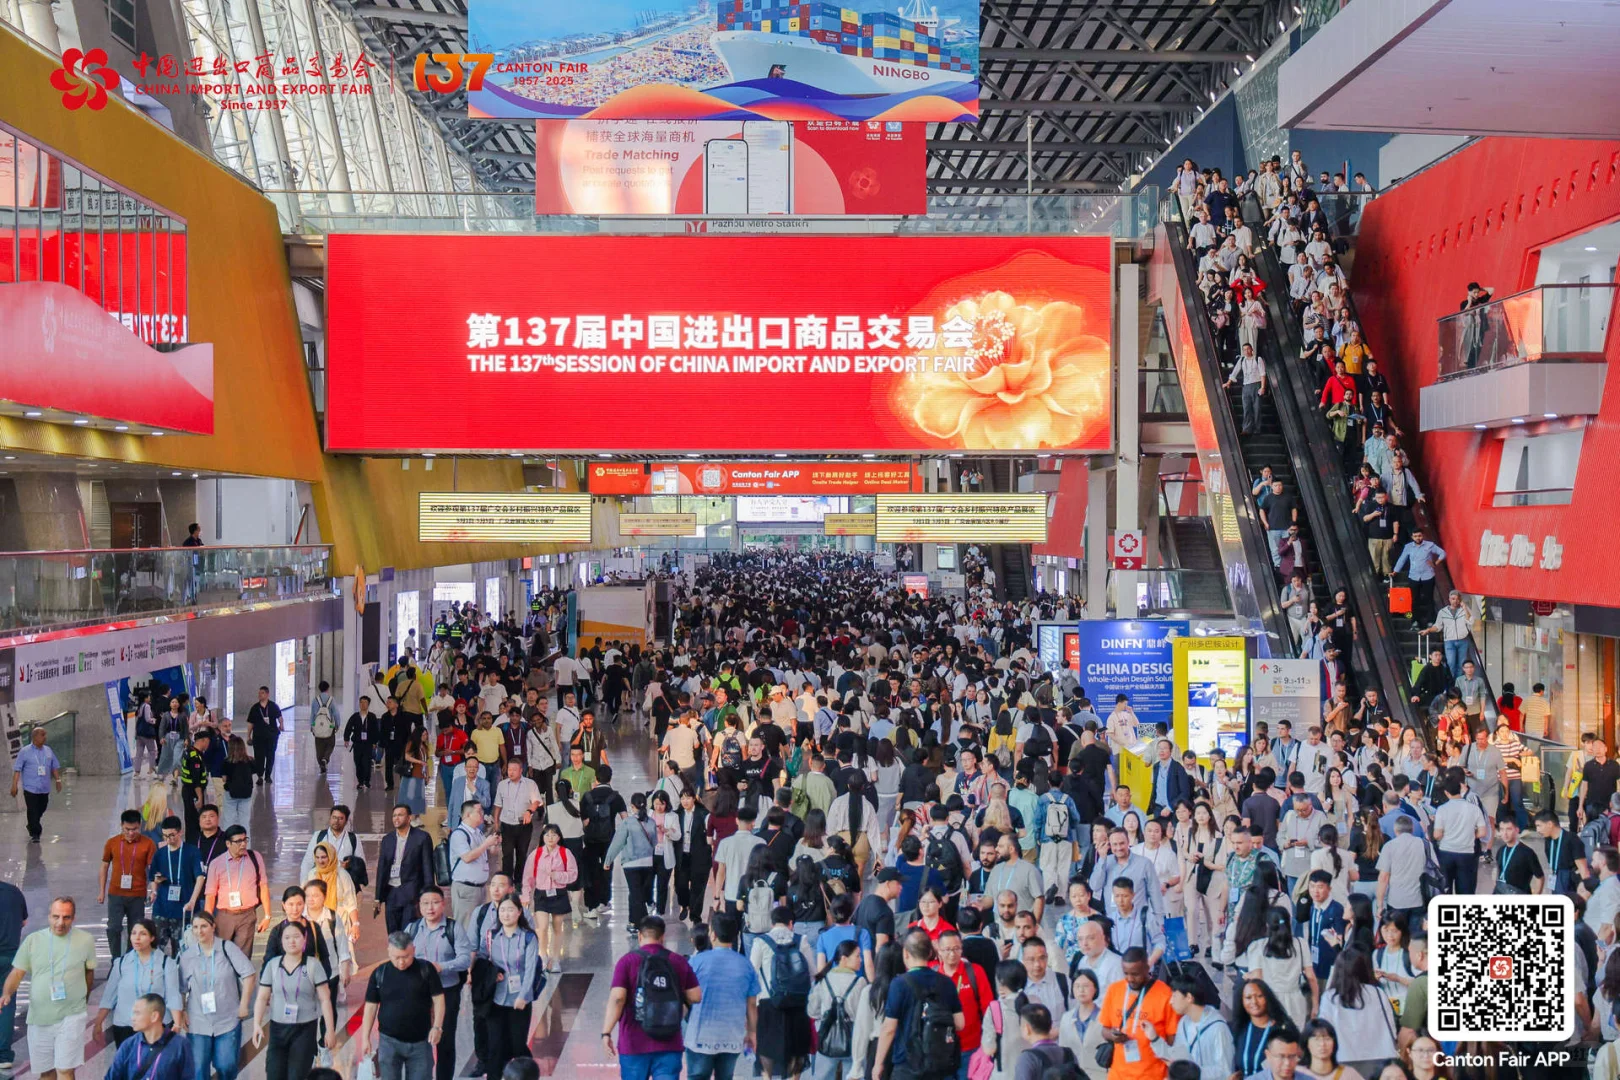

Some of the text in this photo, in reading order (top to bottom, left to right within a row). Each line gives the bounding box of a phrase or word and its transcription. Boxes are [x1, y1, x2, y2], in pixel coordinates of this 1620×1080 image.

[873, 64, 930, 81] NINGBO
[586, 131, 696, 143] 捕获全球海量商机
[585, 150, 680, 161] Trade Matching
[466, 313, 975, 349] 第137届中国进出口商品交易会
[467, 355, 506, 372] THE
[640, 355, 667, 372] OF
[670, 355, 729, 373] CHINA
[733, 356, 807, 373] IMPORT
[810, 356, 850, 373] AND
[854, 356, 929, 373] EXPORT
[934, 356, 976, 373] FAIR
[732, 470, 800, 478] Canton Fair APP
[1087, 663, 1173, 675] CHINA DESIG
[1273, 664, 1283, 674] 3F
[653, 976, 667, 987] 49
